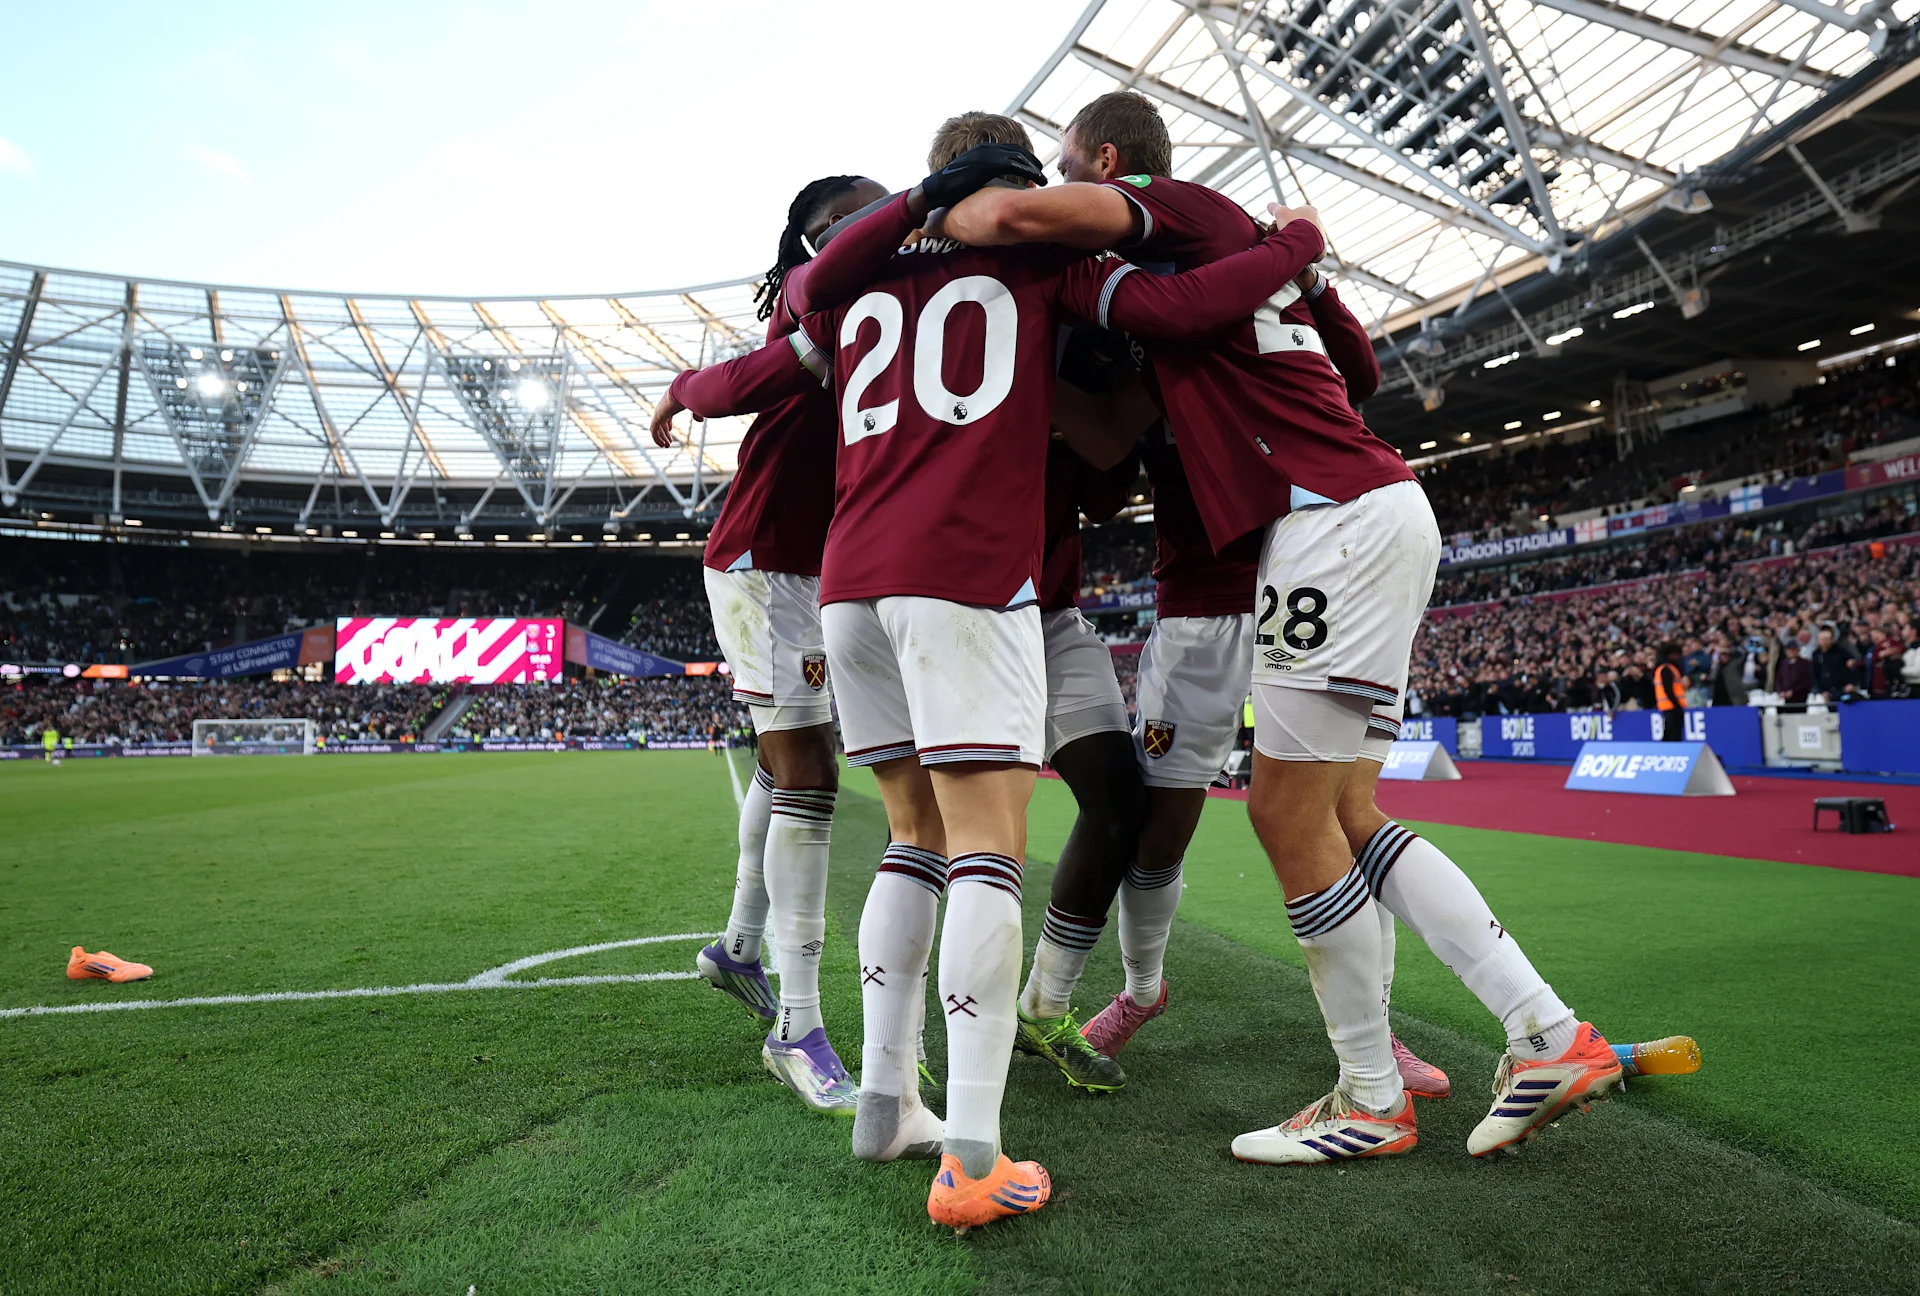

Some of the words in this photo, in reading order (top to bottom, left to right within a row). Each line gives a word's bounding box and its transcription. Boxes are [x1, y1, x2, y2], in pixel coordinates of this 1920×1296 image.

[1253, 279, 1327, 356] 2
[840, 275, 1018, 446] 20
[1449, 541, 1502, 563] LONDON
[1504, 530, 1567, 554] STADIUM
[1255, 585, 1328, 650] 28
[209, 651, 235, 666] STAY
[236, 638, 295, 657] CONNECTED
[1264, 662, 1292, 671] umbro
[1501, 716, 1535, 740] BOYLE
[1570, 715, 1613, 741] BOYLE
[1651, 711, 1706, 741] BLE
[1576, 753, 1643, 779] BOYLE
[1640, 756, 1690, 773] SPORTS
